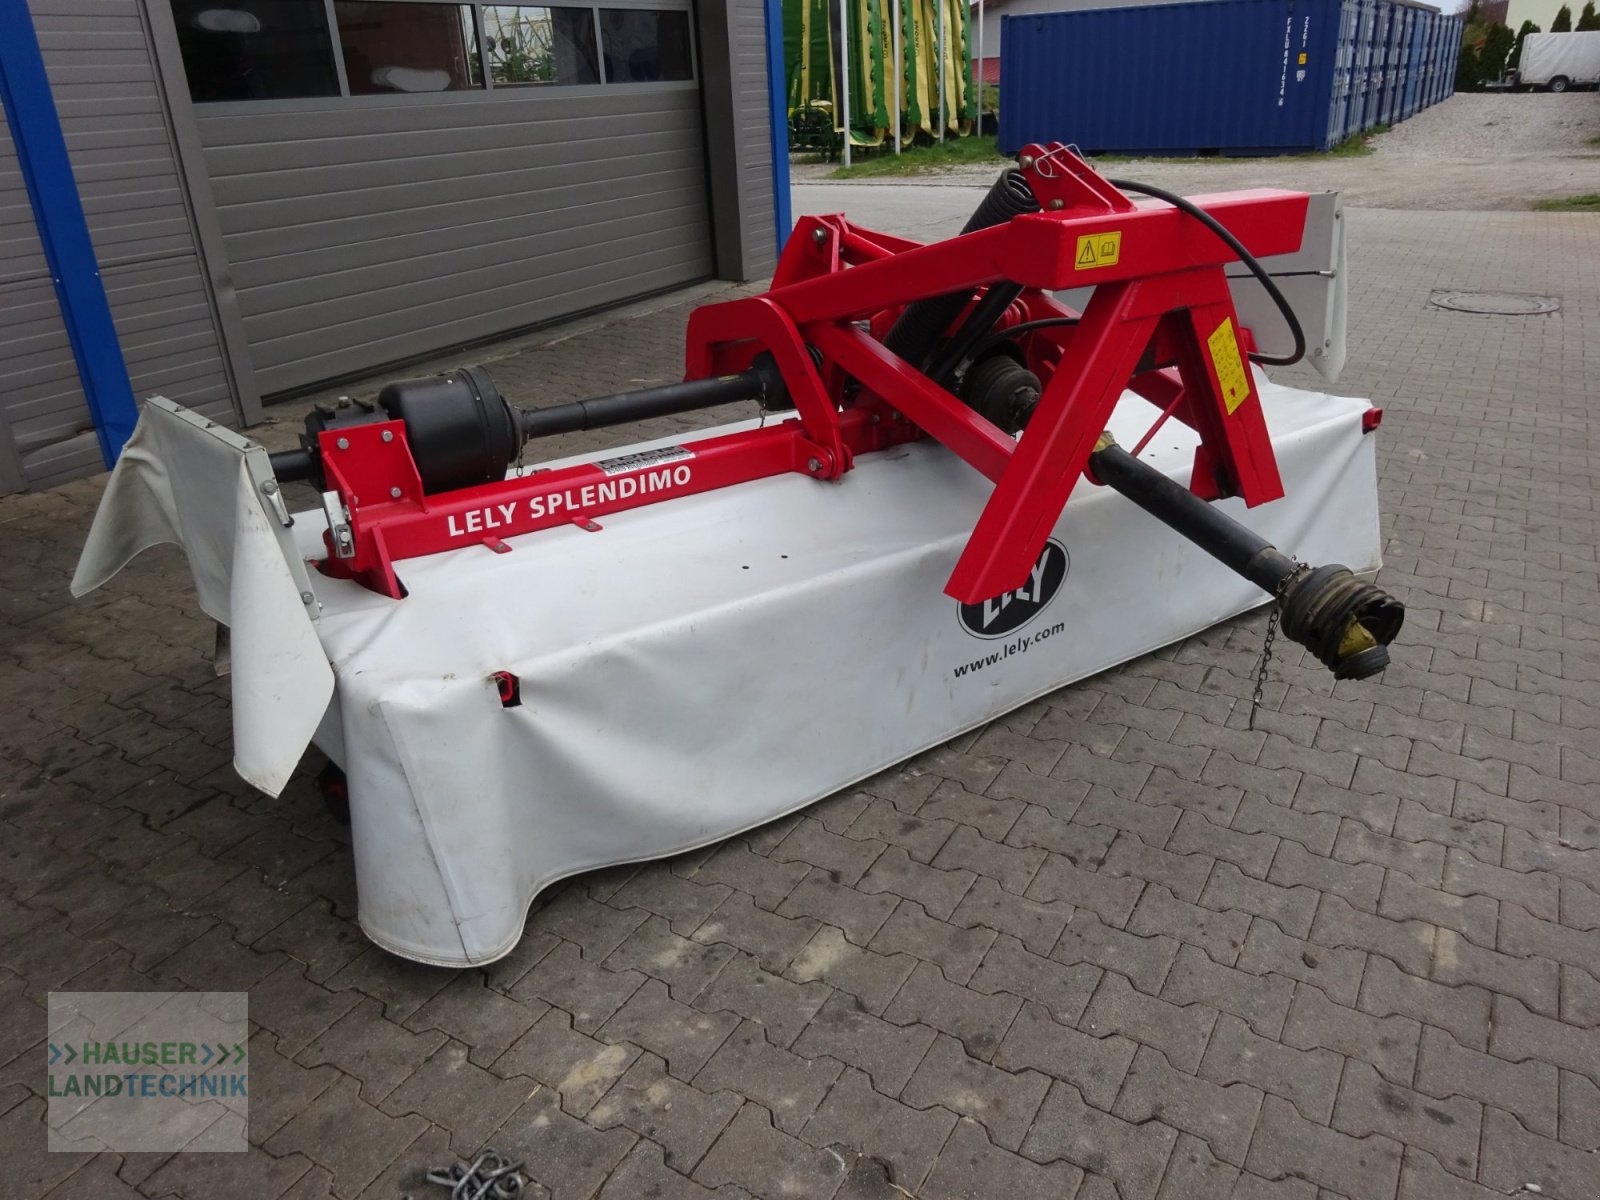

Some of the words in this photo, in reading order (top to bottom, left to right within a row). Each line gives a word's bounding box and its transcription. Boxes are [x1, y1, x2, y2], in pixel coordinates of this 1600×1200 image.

[448, 502, 517, 537] LELY
[529, 465, 692, 519] SPLENDIMO
[953, 622, 1065, 678] www.lely.com
